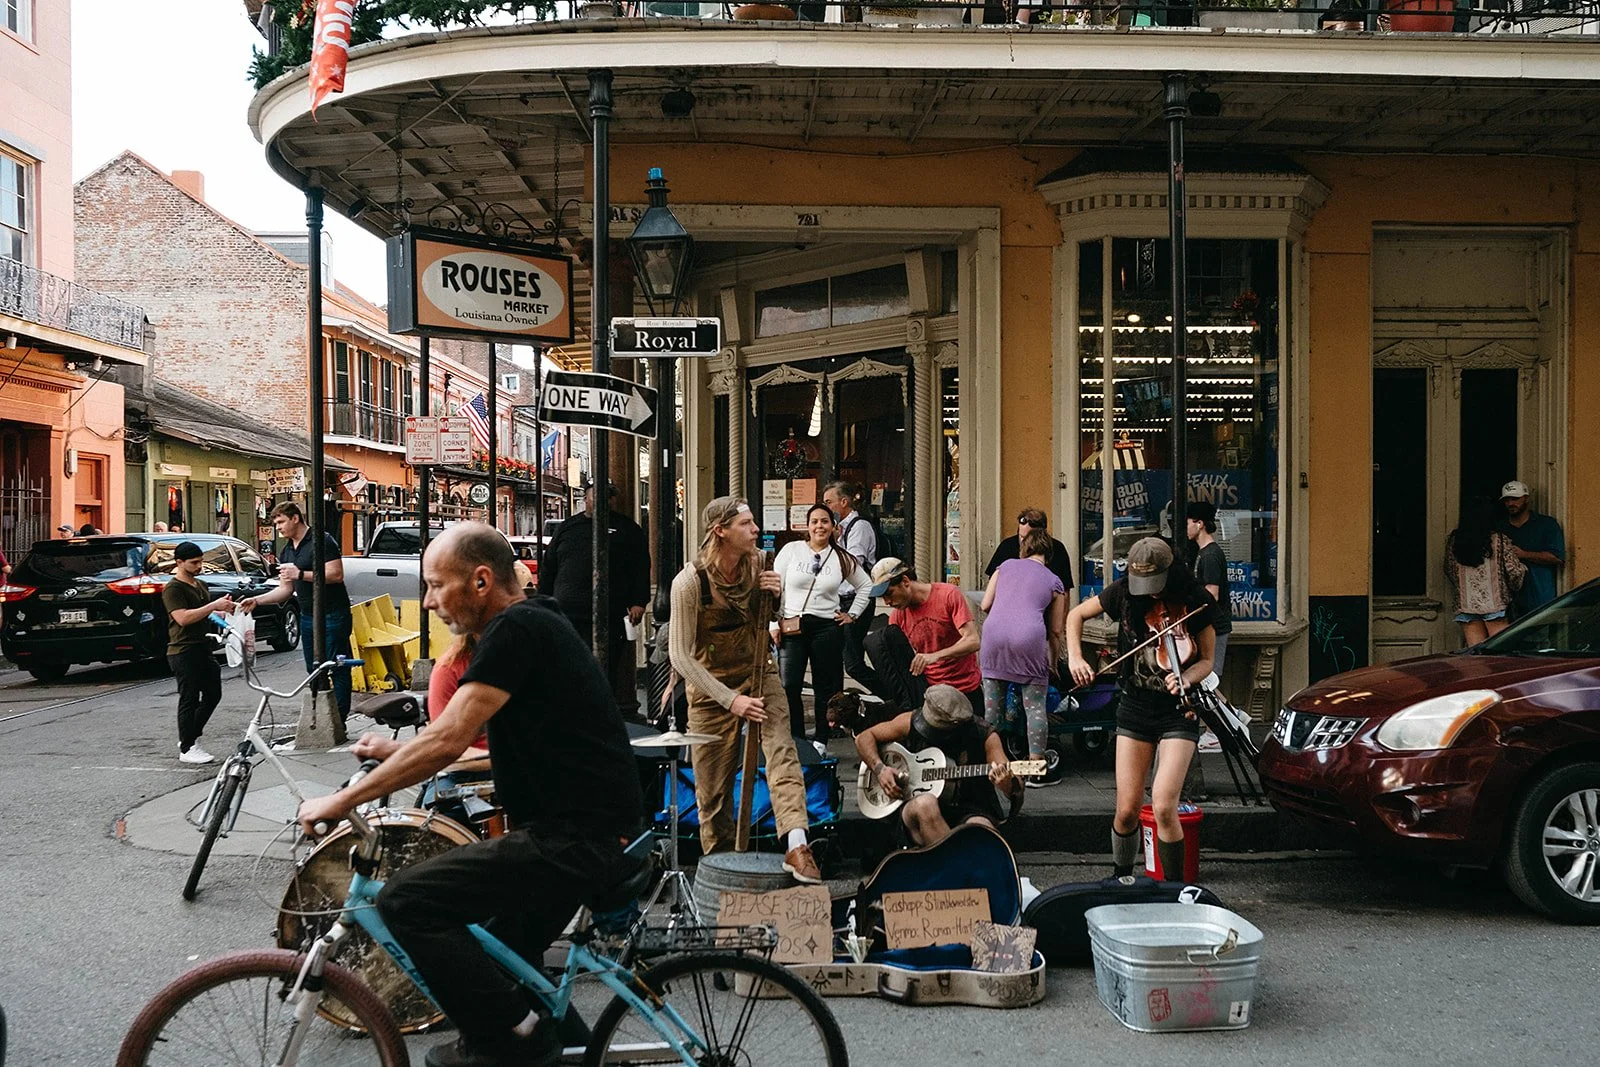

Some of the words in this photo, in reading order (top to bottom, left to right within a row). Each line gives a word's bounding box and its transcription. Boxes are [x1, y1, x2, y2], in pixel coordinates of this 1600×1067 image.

[441, 260, 541, 298] ROUSES
[504, 300, 549, 314] MARKET
[455, 308, 502, 322] Louisiana
[505, 313, 538, 325] Owned
[634, 331, 697, 351] Royal
[549, 387, 590, 409] ONE
[599, 391, 629, 415] WAY
[1082, 487, 1103, 500] BU
[1117, 482, 1144, 499] BUD
[1187, 485, 1238, 505] AINTS
[1116, 492, 1149, 511] LIGHT
[1227, 567, 1243, 575] BUD
[1230, 600, 1271, 618] AINTS
[724, 891, 782, 918] PLEASE
